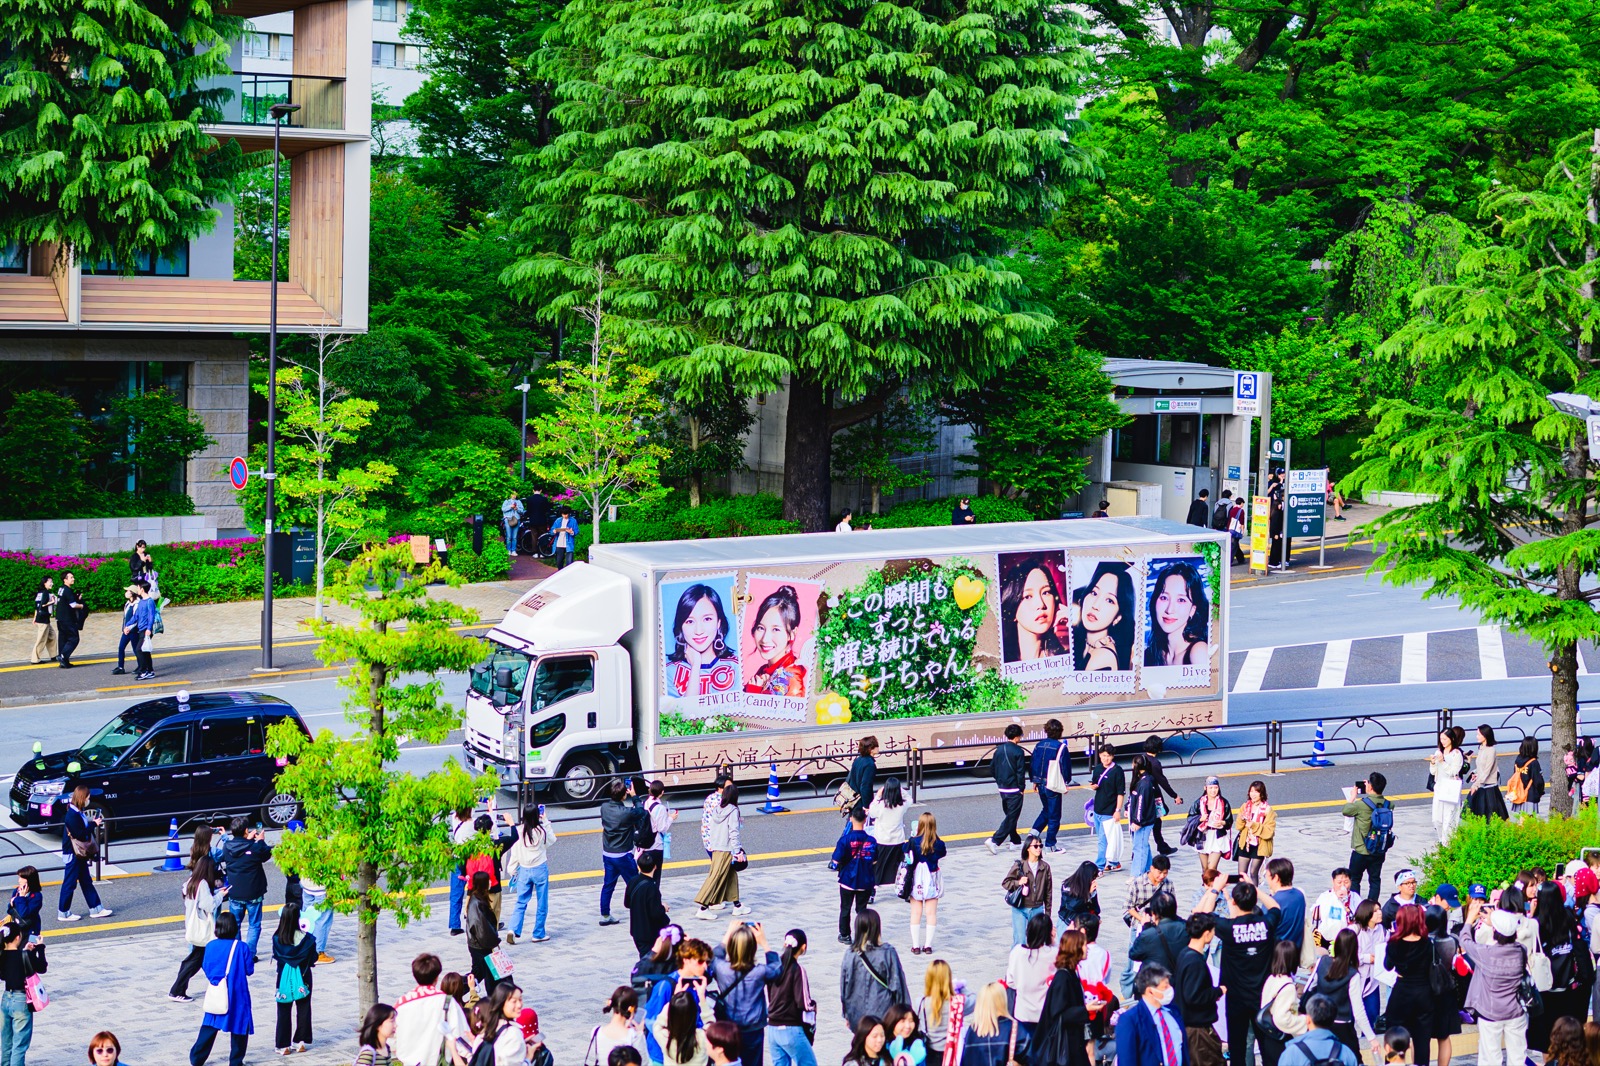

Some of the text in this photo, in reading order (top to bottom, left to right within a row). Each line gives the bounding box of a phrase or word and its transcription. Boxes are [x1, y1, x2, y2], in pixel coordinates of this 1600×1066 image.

[847, 577, 948, 619] この瞬間も
[870, 606, 926, 640] ずっと
[832, 618, 975, 679] 輝き続けている
[1004, 662, 1042, 676] Perfect
[1044, 655, 1071, 669] World
[1182, 667, 1207, 677] Dive
[849, 648, 968, 700] ミナちゃん
[1075, 672, 1132, 683] Celebrate
[698, 691, 740, 706] #TWICE
[746, 696, 781, 710] Candy
[783, 699, 804, 712] Pop
[1232, 921, 1267, 934] TEAM
[1233, 931, 1268, 943] TWICE
